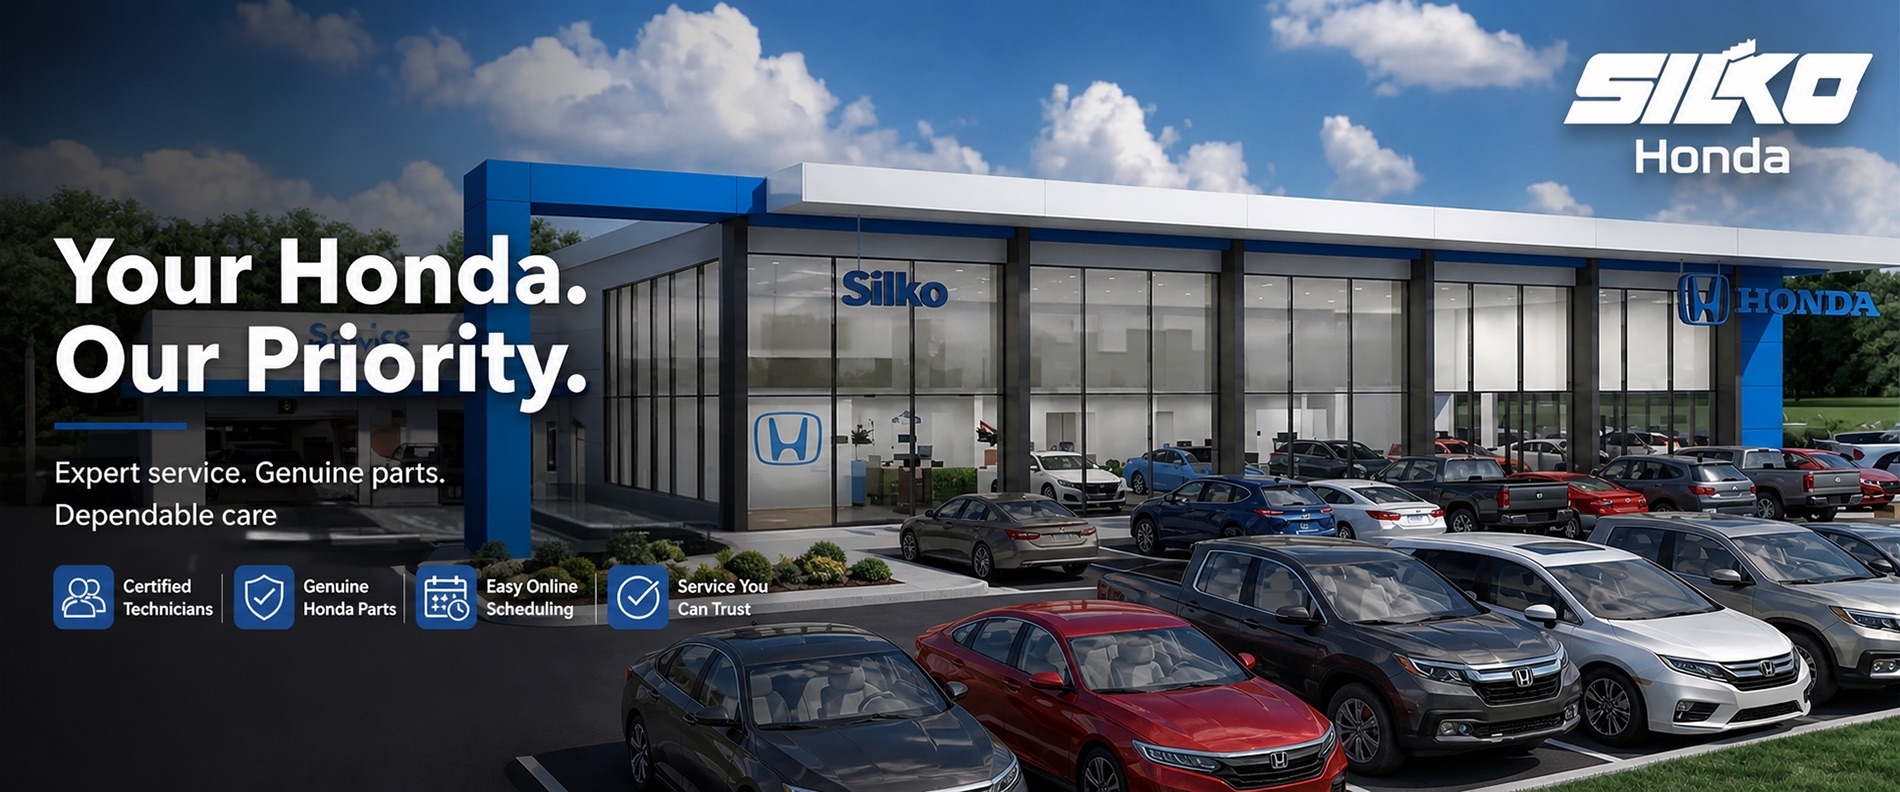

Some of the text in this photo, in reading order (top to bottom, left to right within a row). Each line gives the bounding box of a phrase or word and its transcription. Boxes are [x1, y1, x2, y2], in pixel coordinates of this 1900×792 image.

[841, 270, 949, 308] Silko
[1735, 287, 1881, 317] HONDA
[308, 322, 411, 352] Sevice
